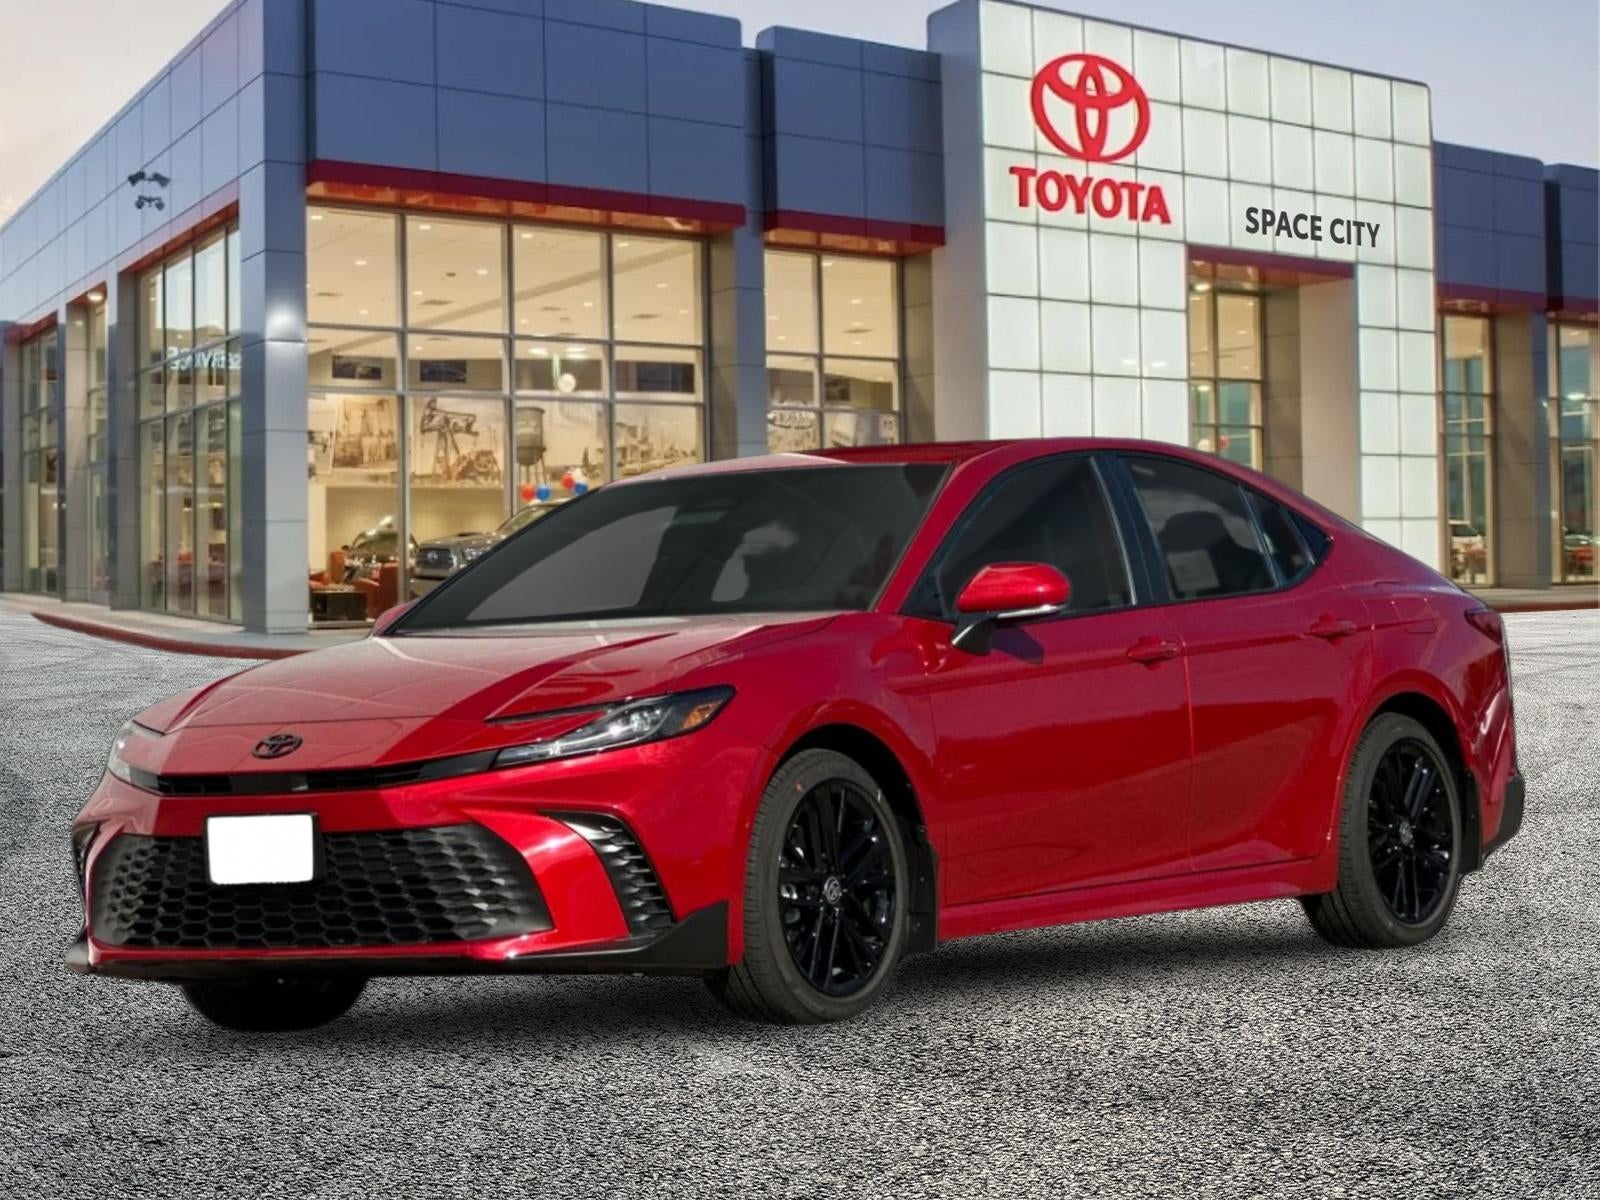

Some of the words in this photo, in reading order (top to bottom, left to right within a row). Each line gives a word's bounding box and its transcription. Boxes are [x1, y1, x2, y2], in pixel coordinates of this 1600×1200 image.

[1009, 166, 1171, 224] TOYOTA
[1245, 206, 1323, 242] SPACE
[1329, 217, 1381, 248] CITY
